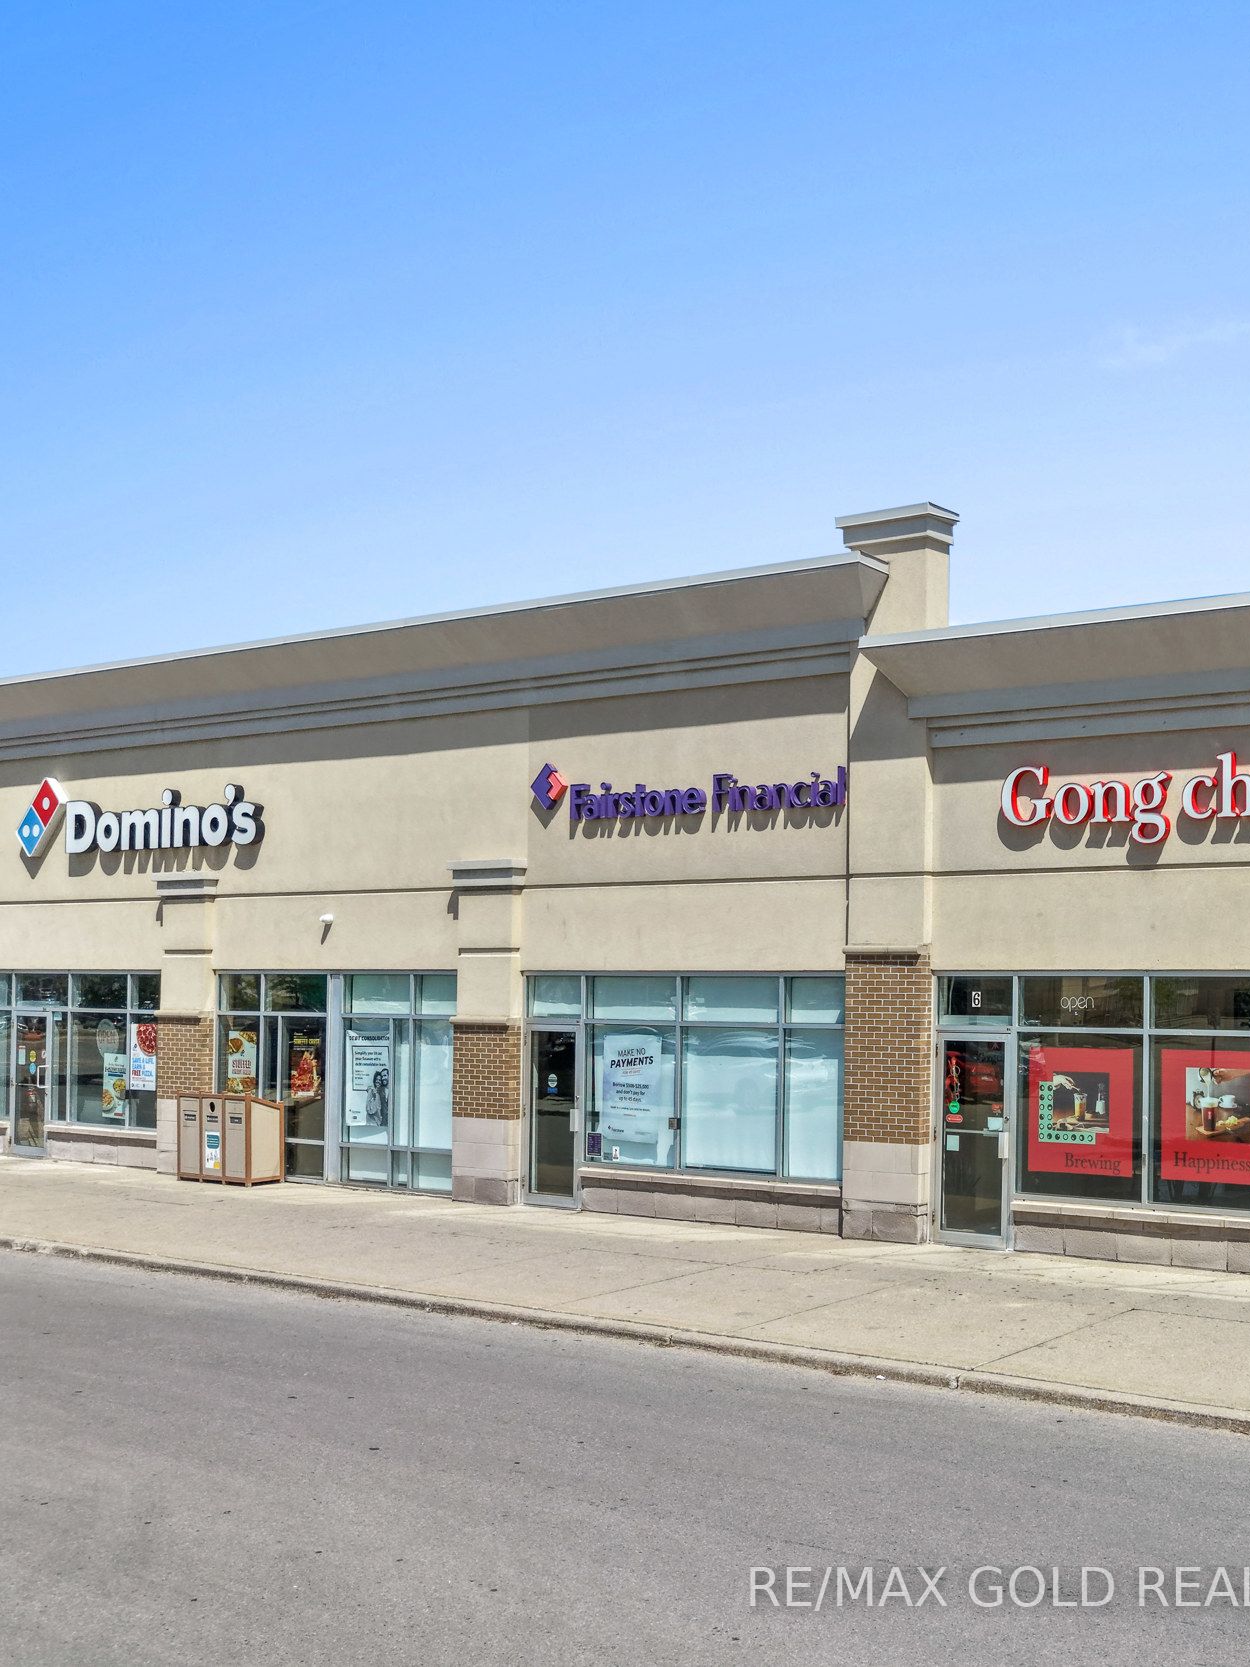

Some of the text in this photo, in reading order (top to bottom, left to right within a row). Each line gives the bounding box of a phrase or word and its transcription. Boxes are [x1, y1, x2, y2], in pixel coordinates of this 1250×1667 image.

[570, 766, 846, 820] Fairstone Financial
[1001, 764, 1173, 844] Gong
[65, 783, 262, 853] Domino's
[973, 993, 981, 1007] 6
[1060, 996, 1095, 1012] open
[610, 1055, 654, 1068] PAYMENTS
[617, 1047, 646, 1057] MAKE NO
[1064, 1152, 1121, 1175] Brewing
